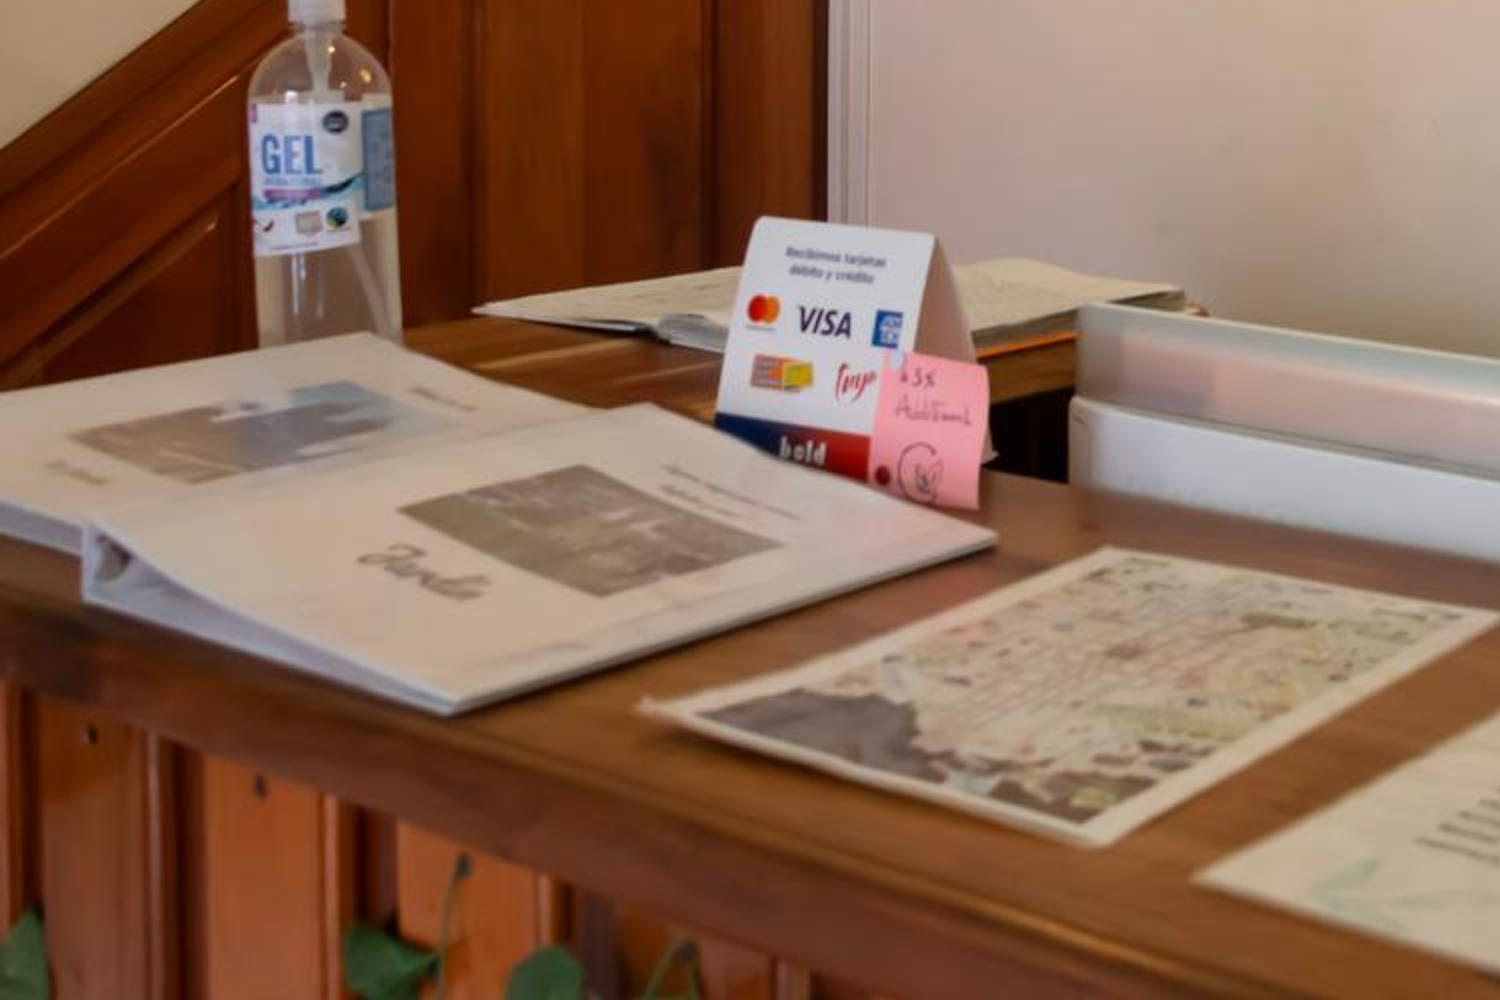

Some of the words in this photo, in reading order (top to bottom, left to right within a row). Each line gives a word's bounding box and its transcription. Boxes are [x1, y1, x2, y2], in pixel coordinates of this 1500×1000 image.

[261, 133, 323, 175] GEL
[798, 305, 852, 339] VISA
[779, 436, 827, 466] bold
